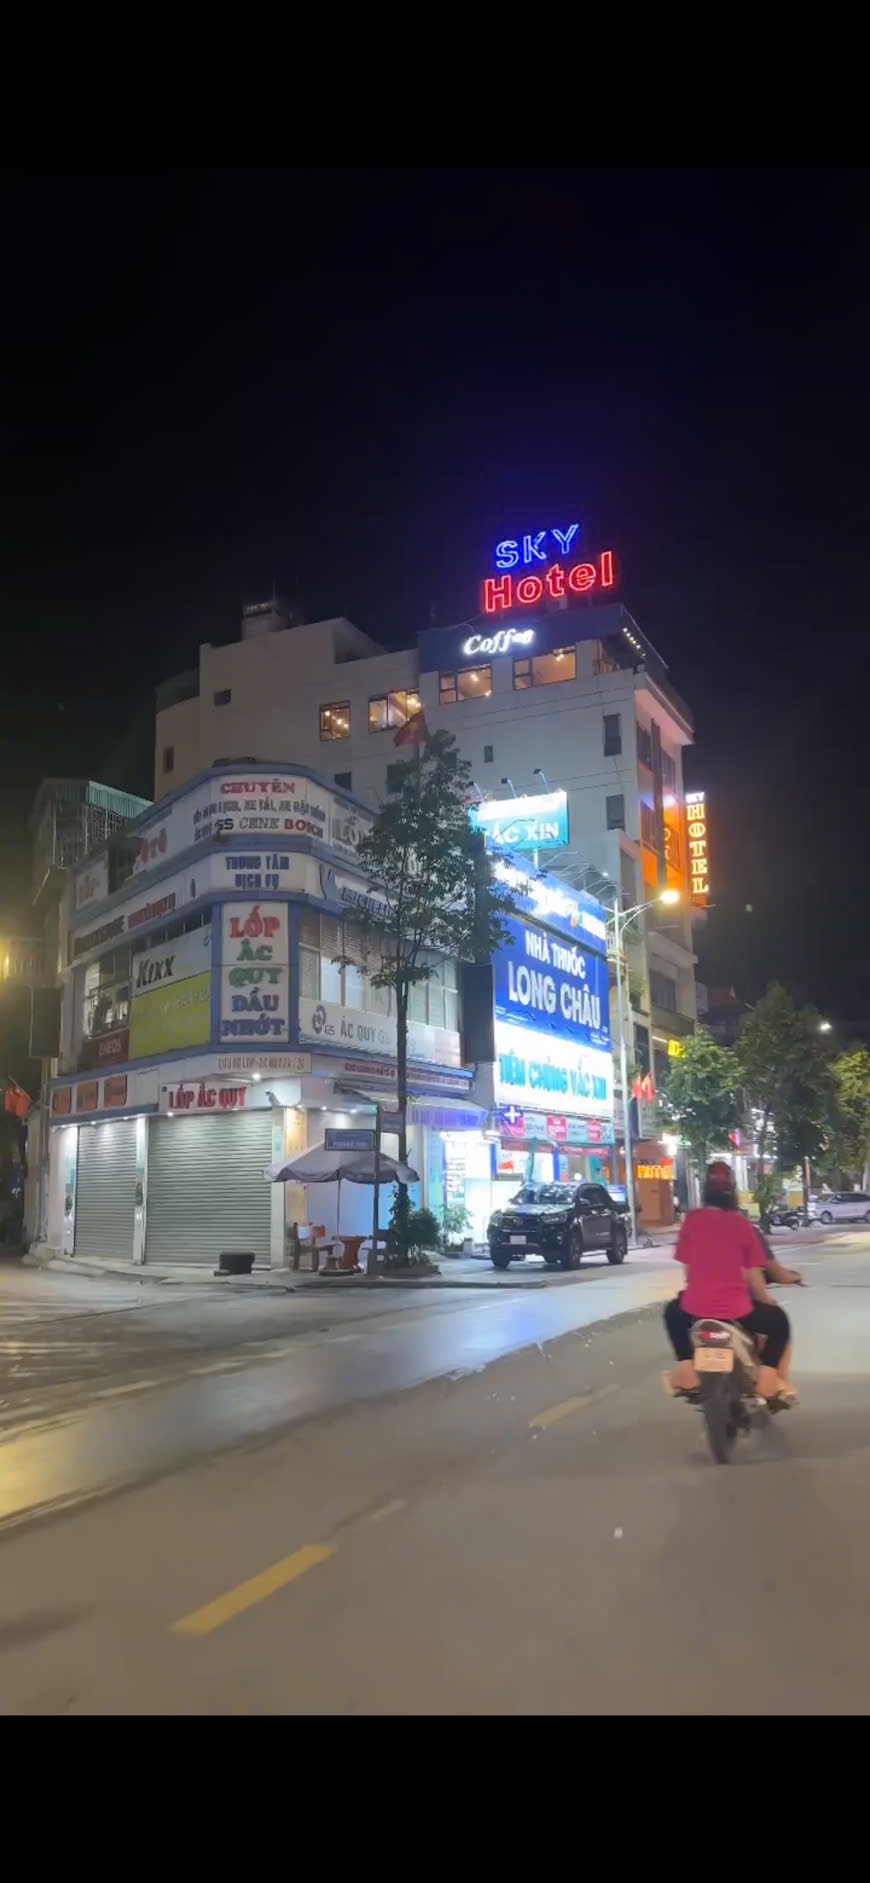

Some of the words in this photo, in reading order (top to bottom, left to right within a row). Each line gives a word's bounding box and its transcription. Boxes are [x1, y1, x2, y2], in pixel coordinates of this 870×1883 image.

[496, 524, 579, 568] SKY
[484, 551, 613, 612] Hotel
[284, 818, 323, 839] BOSCH
[266, 852, 289, 870] TÂM
[687, 804, 709, 893] HOTEL
[229, 903, 281, 938] LỐP
[525, 927, 551, 964] NHÀ
[229, 967, 283, 988] QUY
[508, 961, 557, 1014] LONG
[560, 976, 601, 1031] CHÂU
[357, 1025, 376, 1042] QUY
[219, 1087, 247, 1109] QUY
